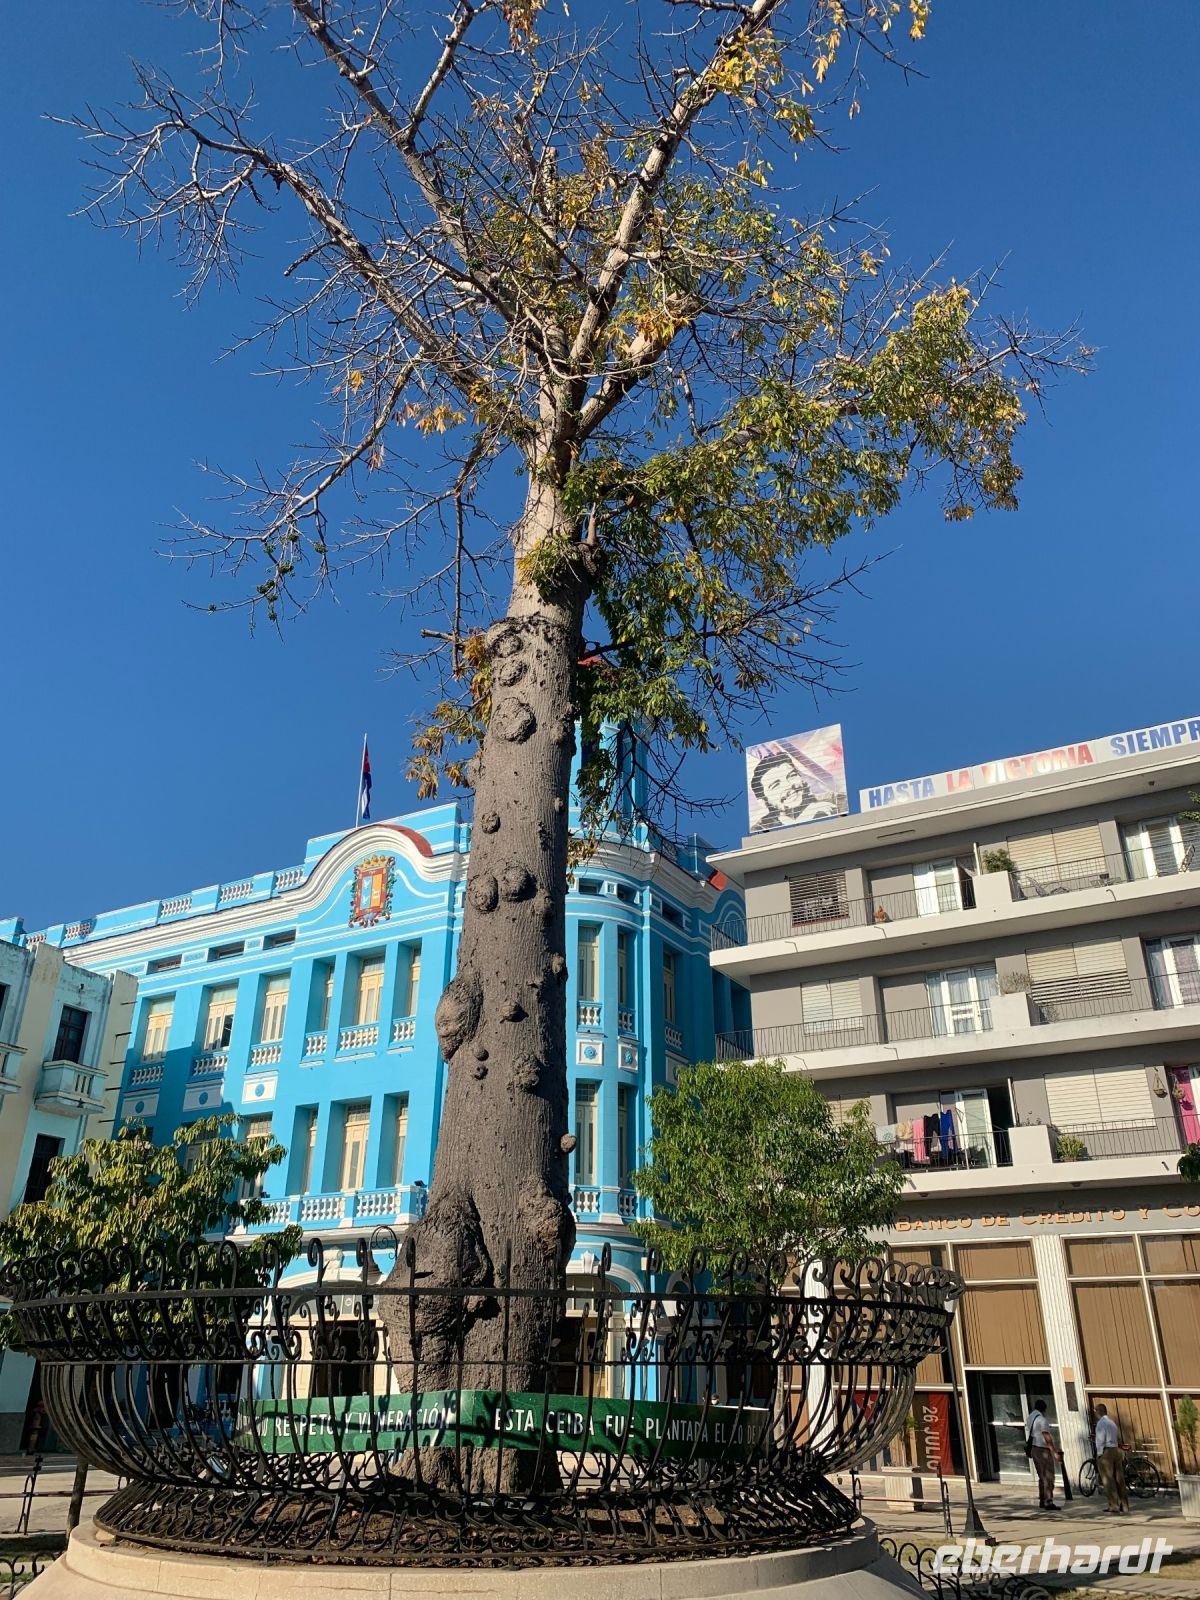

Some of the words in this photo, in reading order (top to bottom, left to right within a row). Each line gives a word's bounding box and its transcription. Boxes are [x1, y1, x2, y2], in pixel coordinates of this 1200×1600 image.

[868, 777, 936, 809] HASTA
[945, 770, 972, 793] LA
[980, 743, 1094, 784] VICTORIA
[895, 1213, 973, 1232] BANCO
[981, 1211, 1011, 1228] DE
[1136, 1203, 1150, 1219] Y
[344, 1412, 353, 1434] Y
[494, 1407, 534, 1432] ESTA
[545, 1411, 595, 1436] CEIBA
[714, 1423, 727, 1444] EL
[922, 1405, 939, 1423] 26
[924, 1426, 942, 1471] JULIO
